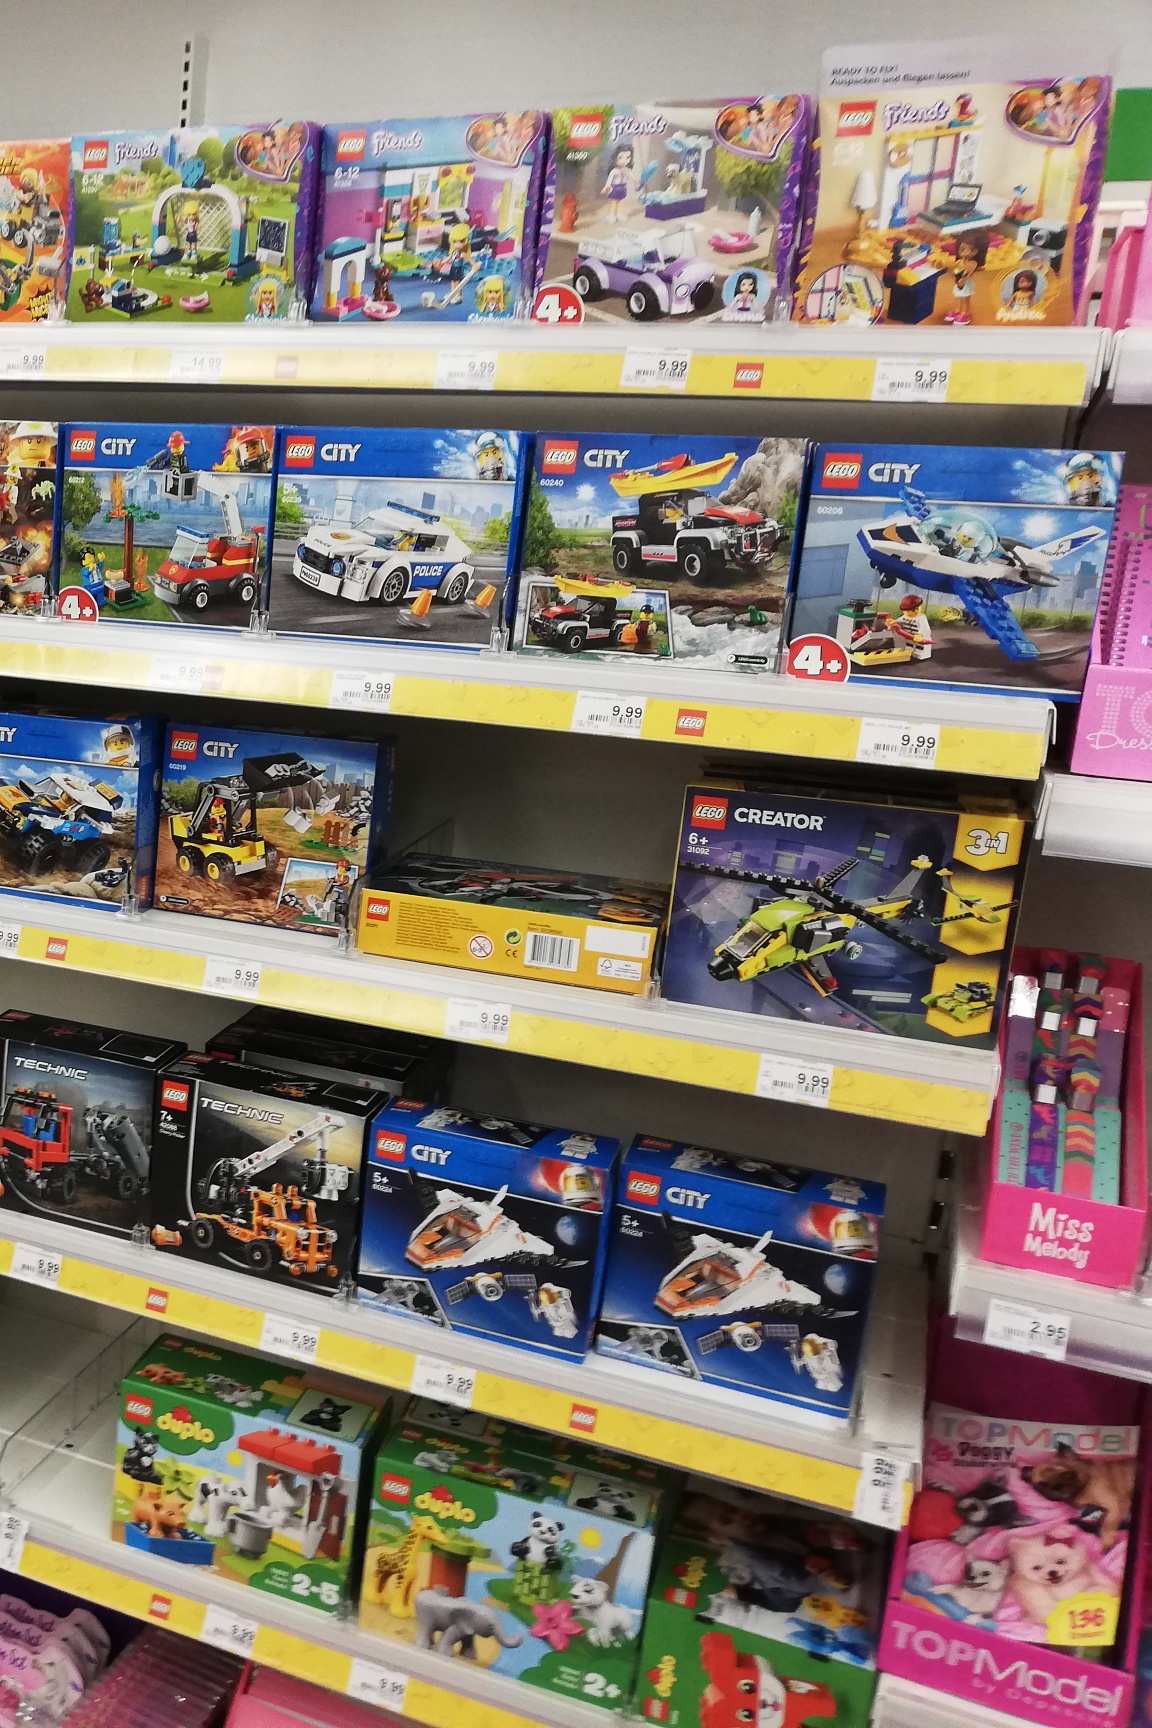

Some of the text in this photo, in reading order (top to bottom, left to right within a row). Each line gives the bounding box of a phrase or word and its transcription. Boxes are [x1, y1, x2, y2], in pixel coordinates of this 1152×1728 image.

[883, 73, 901, 83] und
[840, 99, 951, 131] LEGO Friends
[571, 115, 669, 141] LEGO Friends
[338, 130, 424, 153] LEGO Friends
[84, 142, 159, 163] LEGO Friends
[536, 293, 578, 321] 4+
[71, 437, 137, 457] LEGO CITY
[286, 442, 361, 463] LEGO CITY
[544, 448, 630, 469] LEGO CITY
[540, 478, 564, 487] 60240
[824, 462, 921, 484] LEGO CITY
[283, 483, 298, 496] 5+
[817, 506, 843, 515] 60206
[413, 564, 444, 578] POLICE
[61, 595, 93, 620] 4+
[793, 645, 842, 673] 4+
[364, 681, 392, 694] 9.99
[612, 705, 643, 719] 9.99
[171, 738, 240, 760] LEGO CITY
[901, 734, 936, 749] 9.99
[693, 805, 824, 831] LEGO CREATOR
[688, 832, 709, 846] 6+
[687, 846, 710, 856] 31092
[367, 904, 389, 916] LEGO
[234, 969, 260, 982] 9.99
[480, 1011, 509, 1026] 9.99
[13, 1056, 89, 1081] TECHNIC
[797, 1072, 830, 1089] 9.99
[160, 1110, 174, 1123] 7+
[163, 1088, 284, 1125] LEGO TECHNIC
[377, 1138, 453, 1166] LEGO CITY
[372, 1172, 390, 1185] 5+
[627, 1179, 712, 1210] LEGO CITY
[621, 1215, 640, 1228] 5+
[1029, 1202, 1094, 1243] Miss
[1023, 1232, 1090, 1270] Melody
[1030, 1320, 1068, 1340] 2.95
[126, 1401, 217, 1445] LEGO duplo
[382, 1479, 477, 1524] LEGO duplo
[290, 1572, 340, 1606] 2-5
[891, 1620, 1124, 1716] TOPModel
[582, 1672, 621, 1698] 2+
